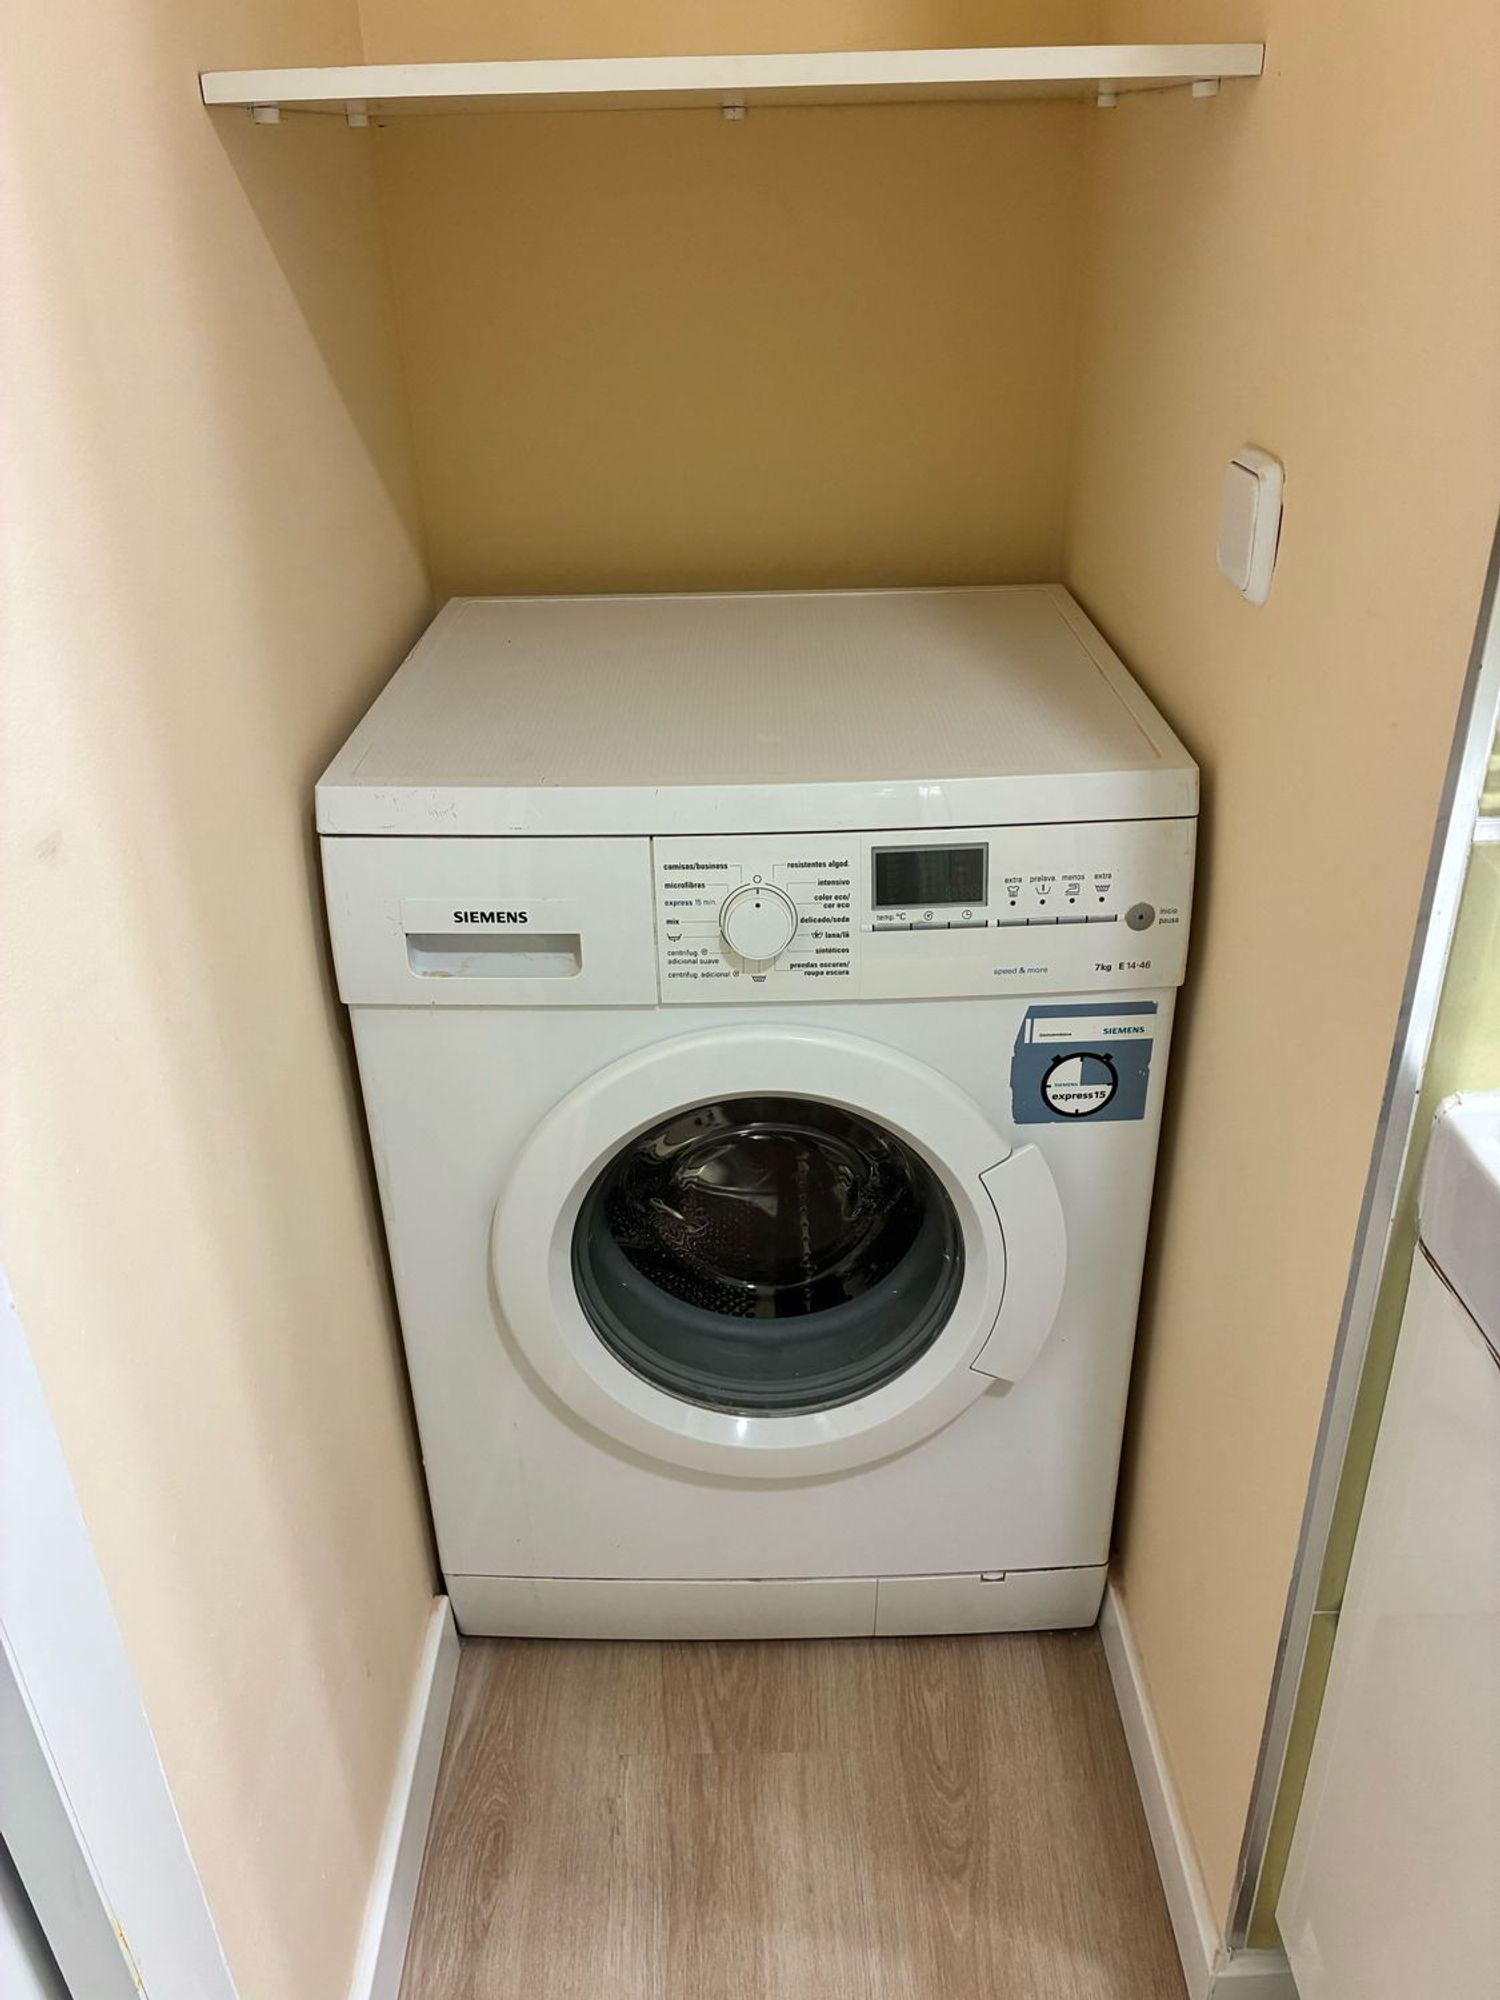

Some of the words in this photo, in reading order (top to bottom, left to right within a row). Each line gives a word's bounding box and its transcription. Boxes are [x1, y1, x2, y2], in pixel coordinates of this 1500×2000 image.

[663, 862, 728, 871] camisas/business
[1004, 876, 1022, 884] extra
[1061, 873, 1085, 881] menos
[1094, 872, 1112, 880] extra
[834, 893, 850, 901] eco/
[664, 900, 694, 908] express
[453, 911, 528, 923] SIEMENS
[800, 916, 850, 924] delicado/seda
[1158, 916, 1179, 924] pausa
[993, 966, 1017, 975] speed
[1018, 966, 1026, 974] &
[1027, 966, 1048, 974] more
[1095, 963, 1112, 972] 7kg
[1118, 962, 1125, 970] E
[1103, 1026, 1145, 1035] SIEMENS
